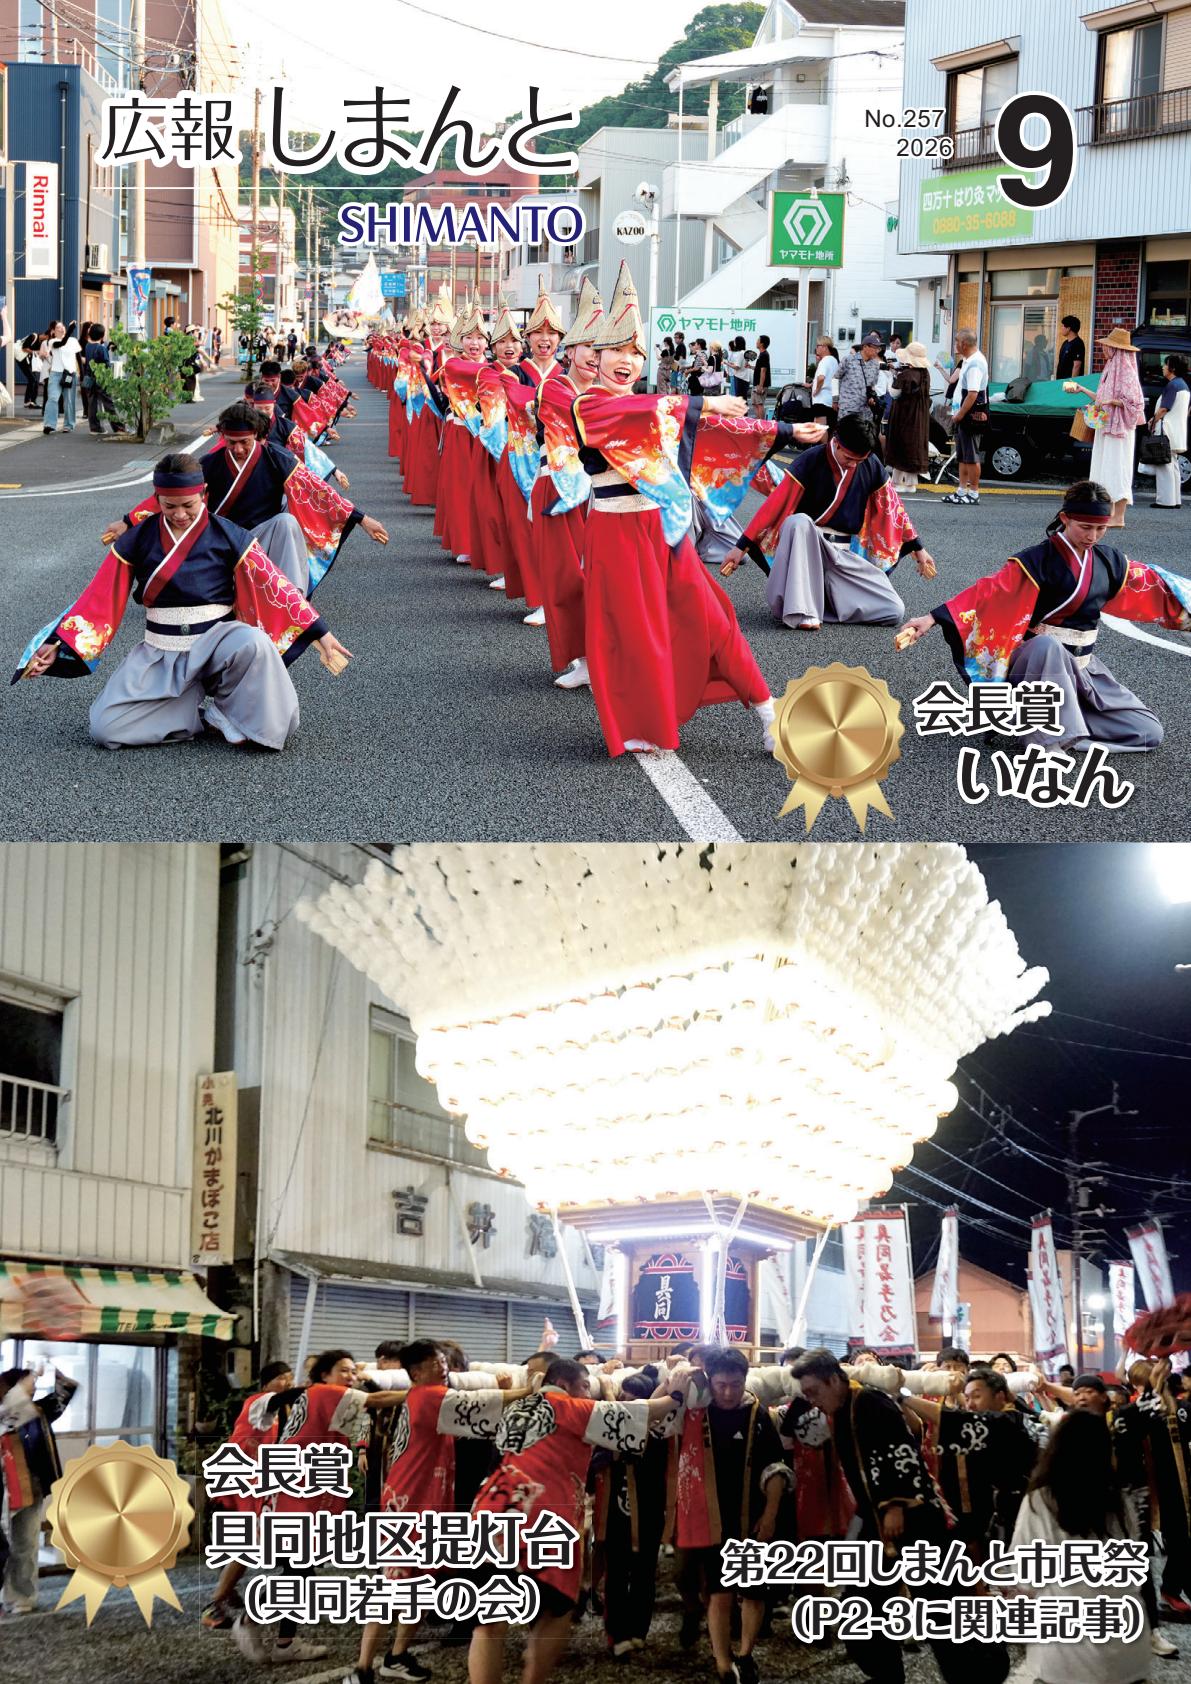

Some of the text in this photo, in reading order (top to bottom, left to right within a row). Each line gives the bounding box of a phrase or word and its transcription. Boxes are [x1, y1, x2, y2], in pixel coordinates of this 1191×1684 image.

[33, 175, 49, 238] Rinnai
[616, 226, 645, 236] KAZOO
[779, 249, 834, 261] ヤマモト地所
[679, 317, 757, 331] ヤマモト地所
[199, 1107, 224, 1251] 北川かまぼこ店
[654, 1275, 674, 1320] 具同
